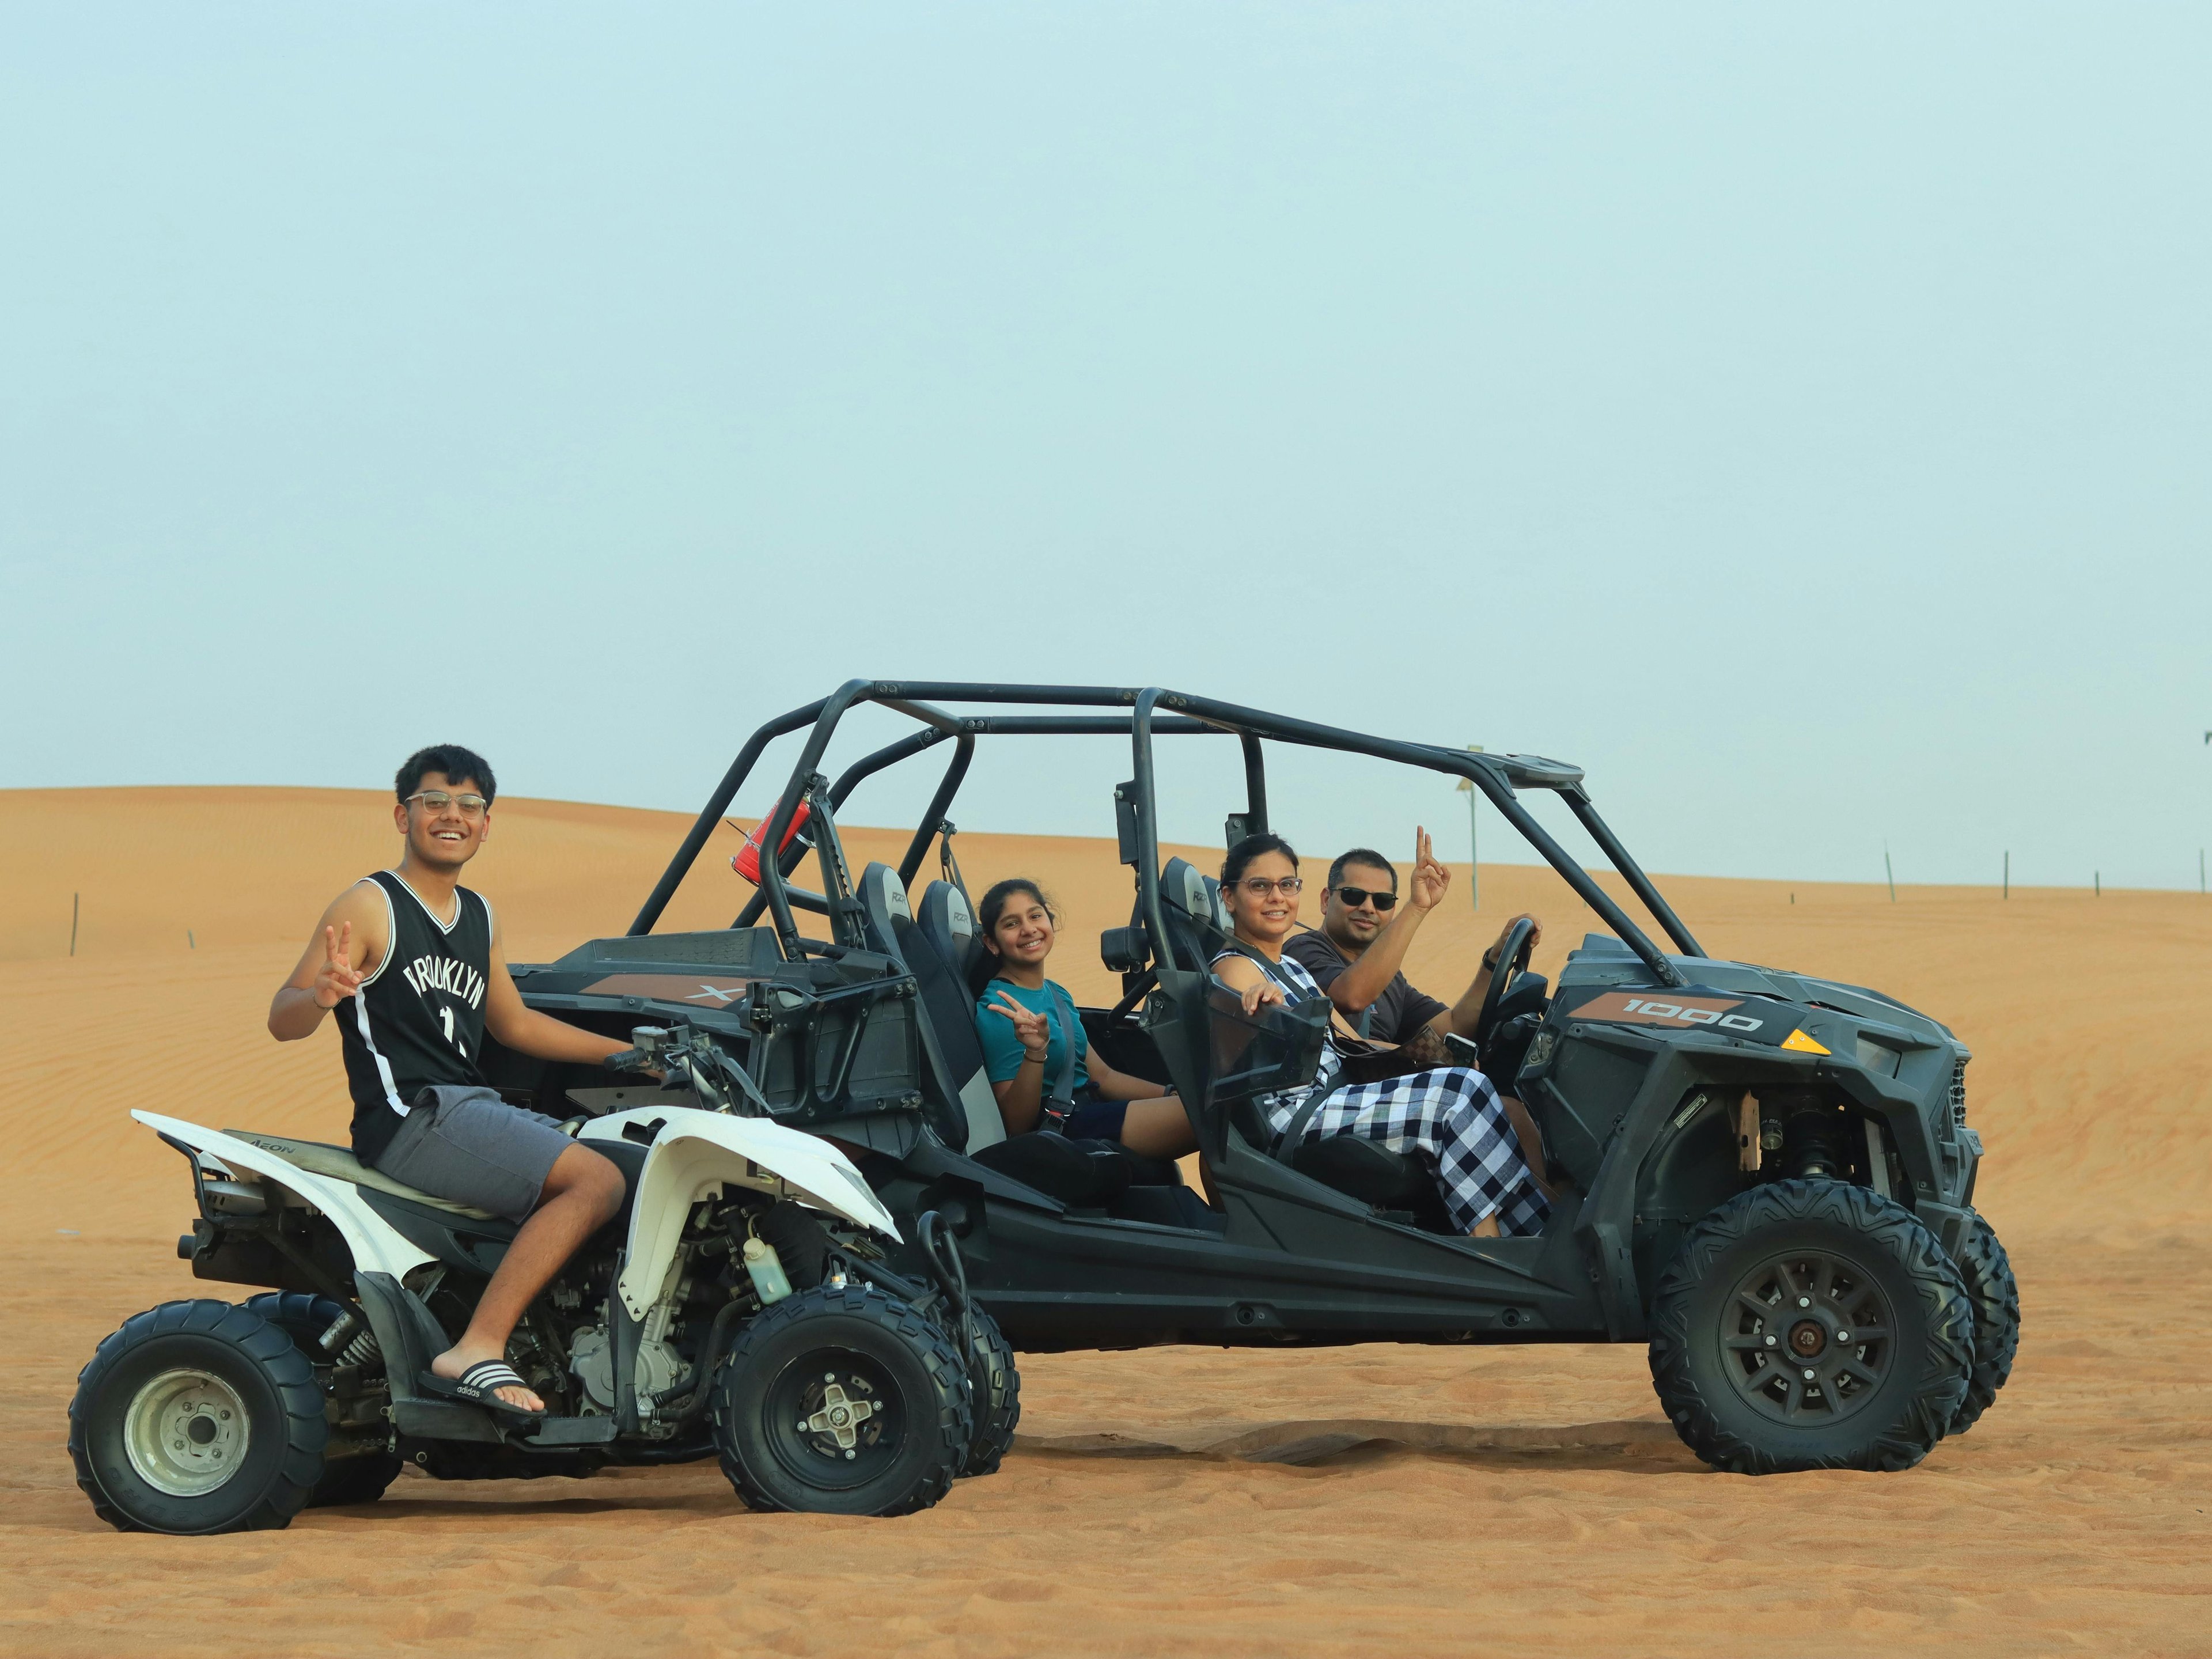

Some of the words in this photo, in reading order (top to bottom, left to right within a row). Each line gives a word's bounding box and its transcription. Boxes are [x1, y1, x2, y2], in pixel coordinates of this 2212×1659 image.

[892, 892, 907, 906] RZR
[1193, 891, 1208, 904] RZR
[953, 912, 968, 923] RZR
[1623, 999, 1764, 1032] 1000
[250, 1139, 296, 1153] AEON
[457, 1385, 480, 1398] adidas
